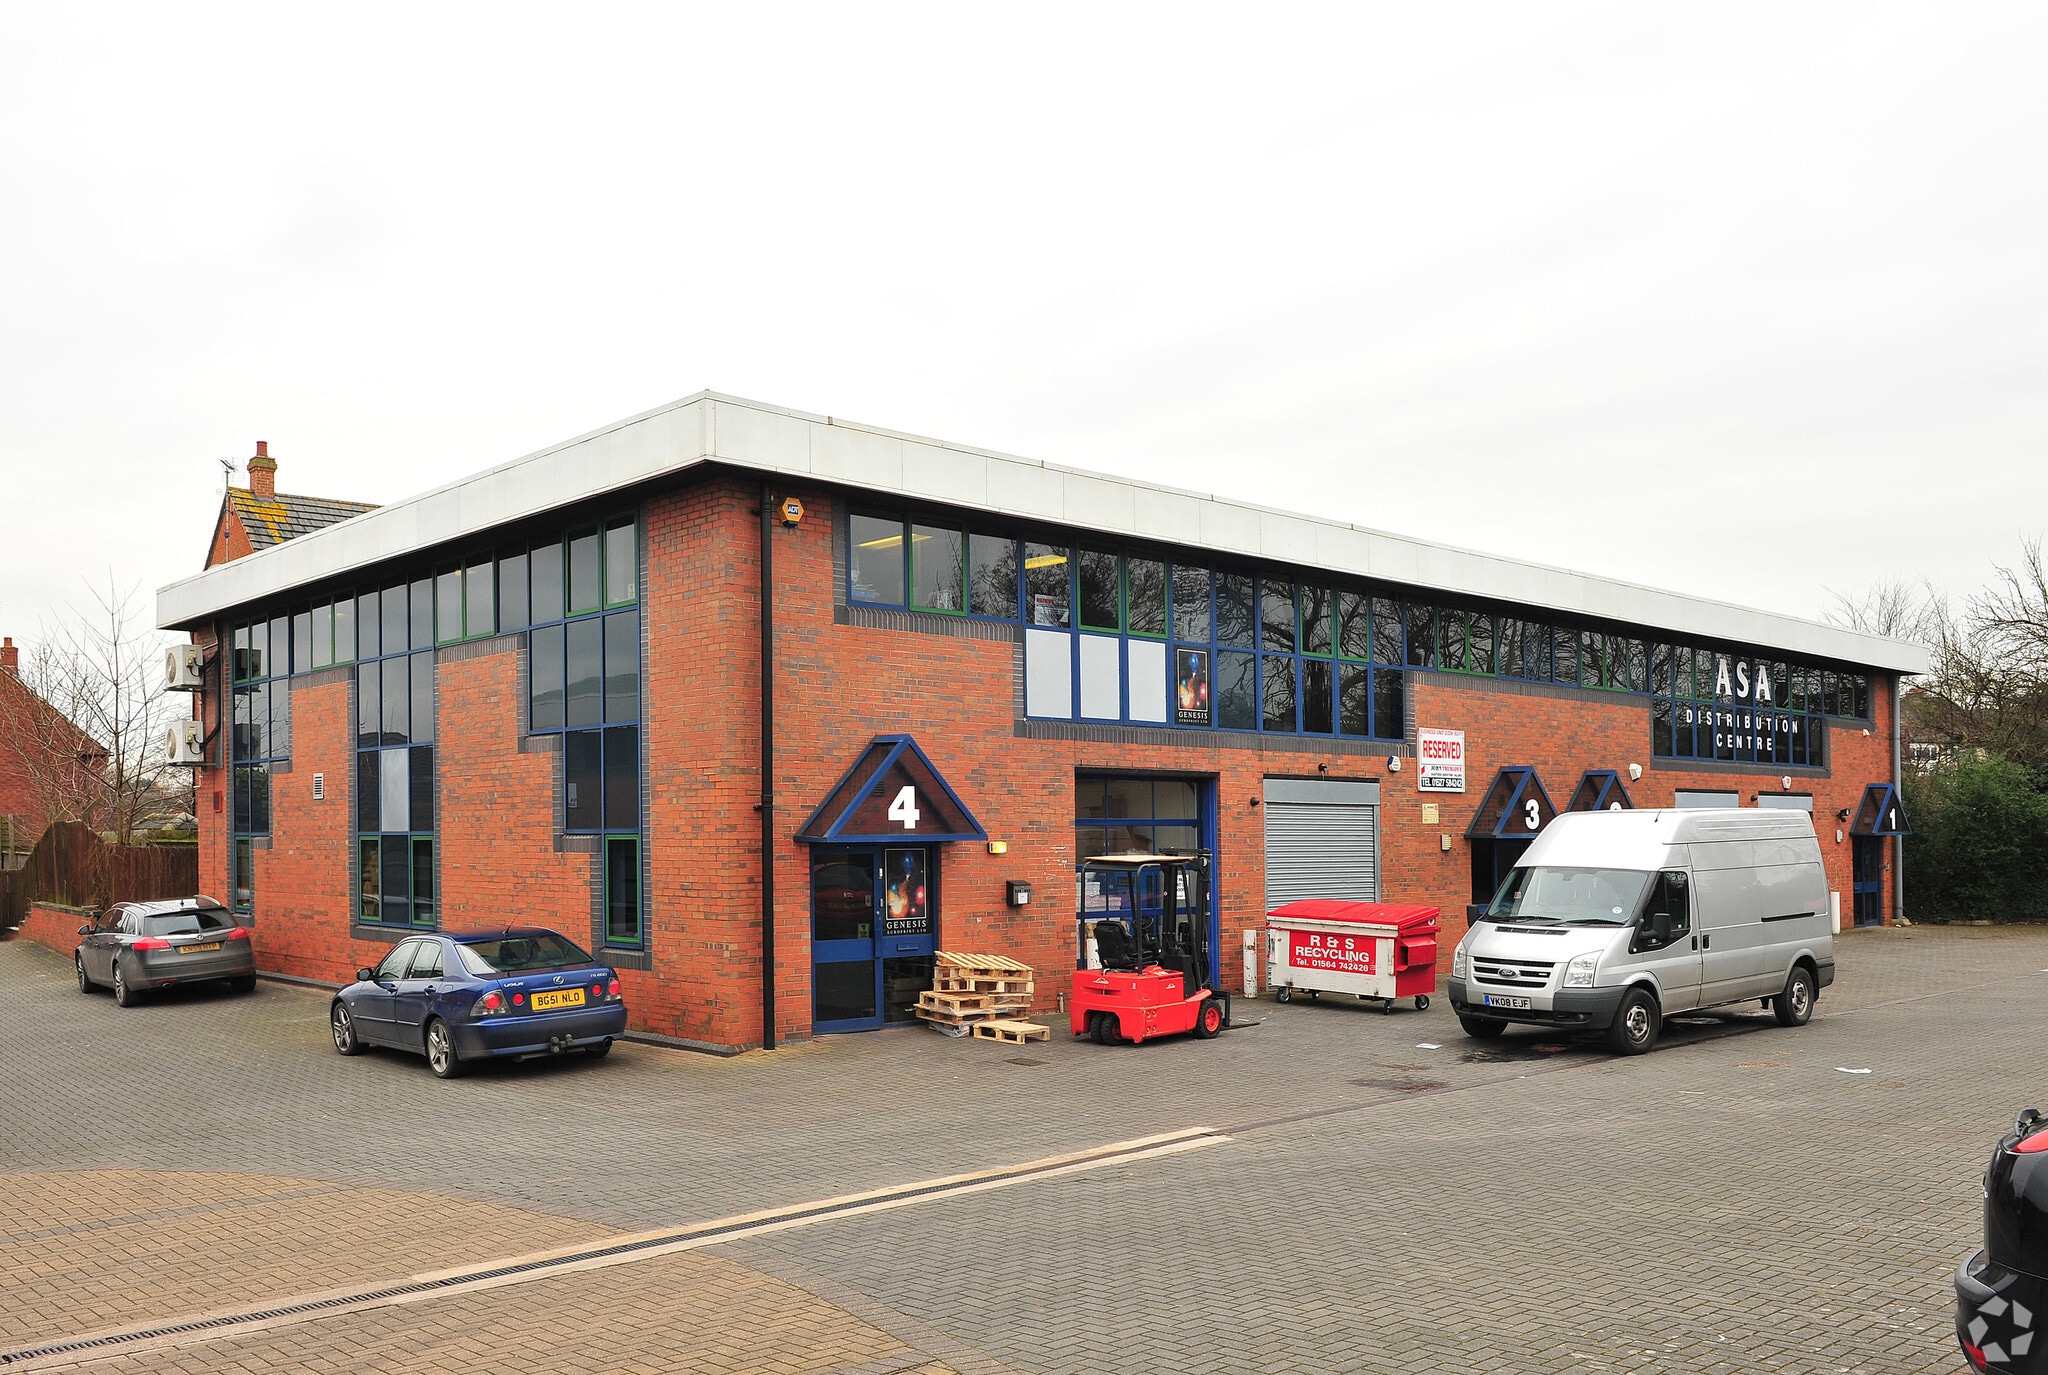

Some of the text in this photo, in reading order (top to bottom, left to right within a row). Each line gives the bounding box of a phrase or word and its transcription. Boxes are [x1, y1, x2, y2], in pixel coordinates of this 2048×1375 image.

[787, 505, 798, 514] ADT
[1715, 658, 1772, 701] ASA
[1178, 711, 1208, 719] GENESIS
[1686, 709, 1798, 734] DISTRIBUTION
[1422, 739, 1462, 759] RESERVED
[1716, 733, 1773, 751] CENTRE
[1421, 777, 1432, 787] TEL
[888, 785, 920, 829] 4
[1525, 799, 1540, 830] 3
[1889, 808, 1896, 830] 1
[886, 920, 927, 929] GENESIS
[1310, 935, 1355, 950] R & S
[1295, 946, 1370, 962] RECYCLING
[1296, 957, 1309, 966] Tel.
[1312, 959, 1336, 968] 01564
[537, 992, 580, 1006] BG51 NLO
[1490, 996, 1528, 1008] VK08 EJF
